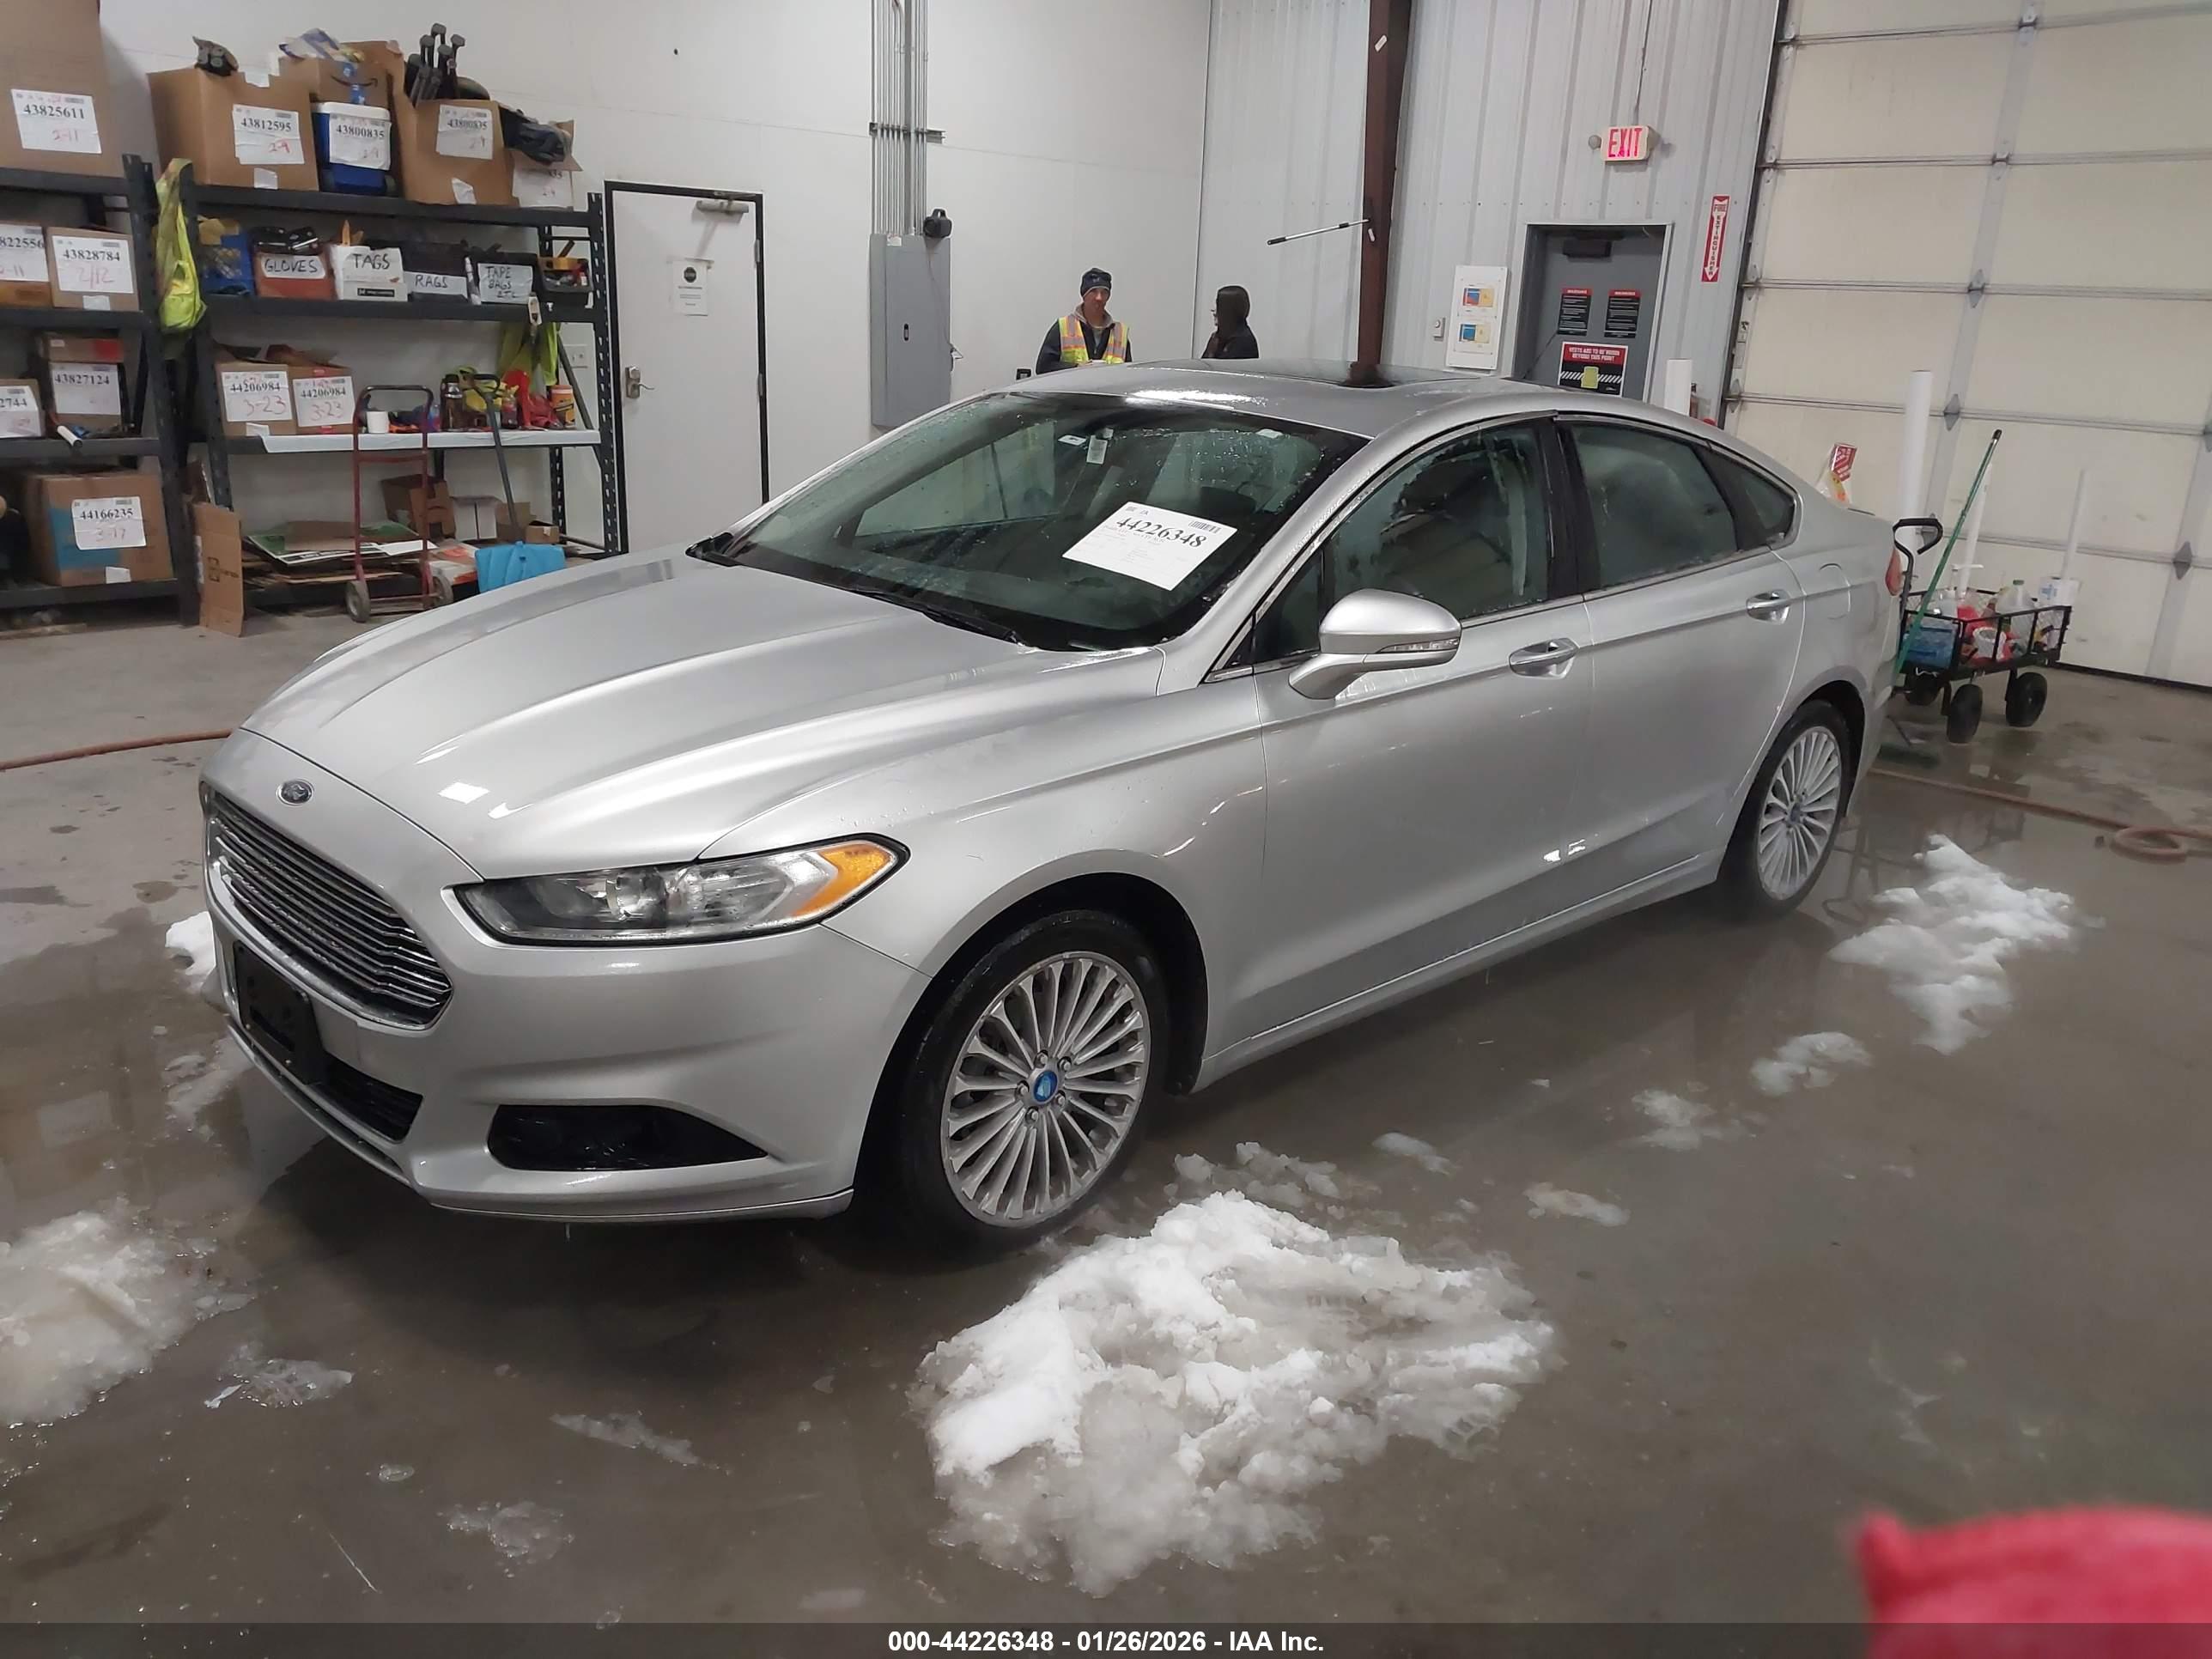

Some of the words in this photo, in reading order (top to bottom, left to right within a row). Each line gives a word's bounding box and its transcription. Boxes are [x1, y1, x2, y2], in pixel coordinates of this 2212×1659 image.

[24, 104, 84, 119] 43825611
[240, 118, 291, 132] 43812595
[336, 125, 385, 140] 43800835
[1607, 128, 1643, 158] EXIT
[1708, 216, 1721, 276] EXTINGUISHER
[63, 249, 120, 262] 43828784
[352, 253, 390, 270] TAGS
[264, 259, 319, 273] GLOVES
[485, 266, 512, 278] TAPE
[415, 274, 448, 289] RAGS
[488, 279, 512, 289] BAGS
[55, 374, 110, 386] 43827124
[229, 382, 281, 393] 44206984
[301, 387, 346, 399] 44206984
[244, 395, 287, 416] 3-23
[311, 401, 343, 422] 3-23
[80, 507, 134, 520] 44166235
[1116, 517, 1207, 548] 44226348
